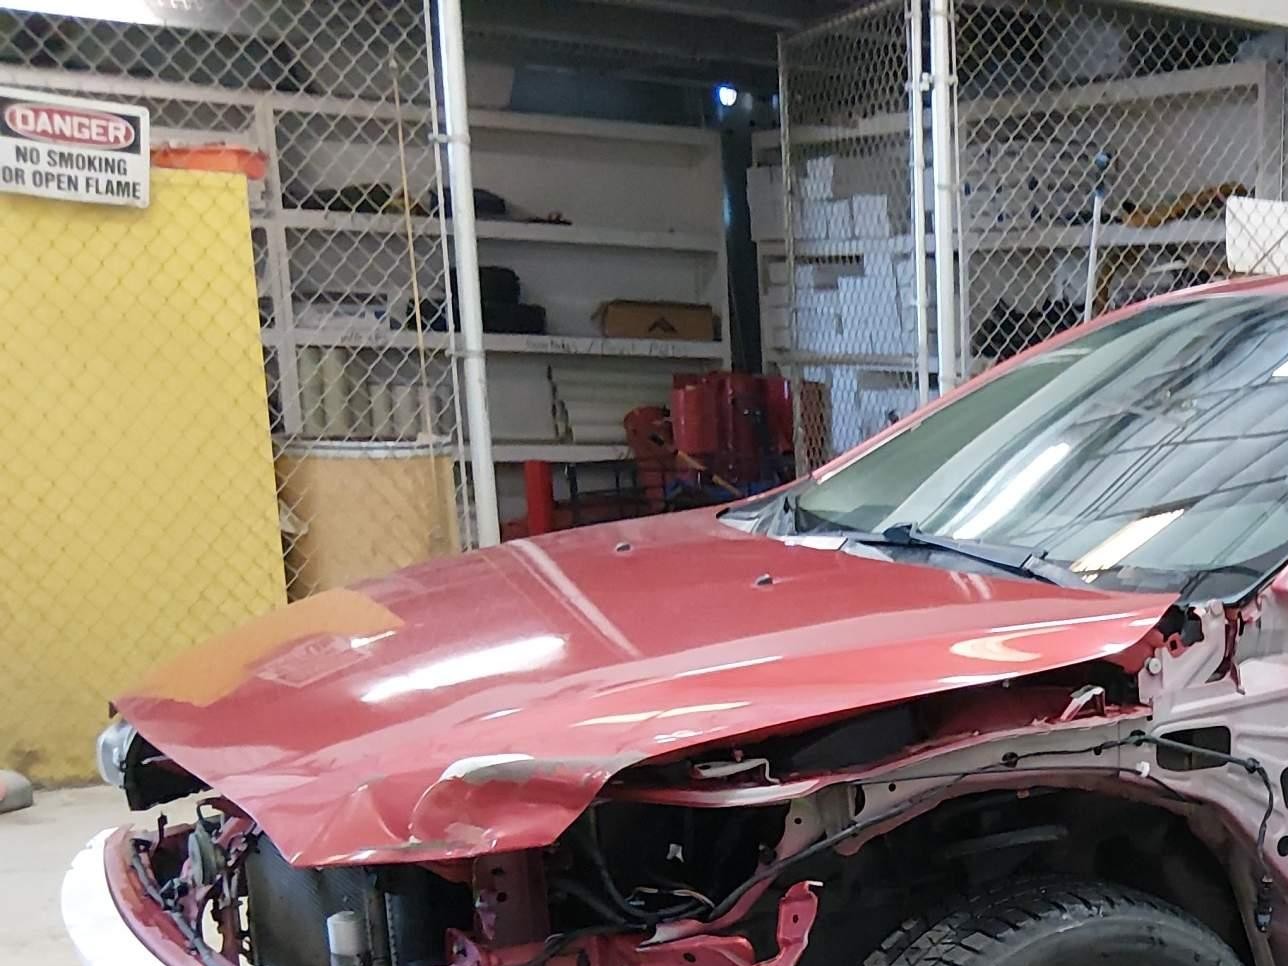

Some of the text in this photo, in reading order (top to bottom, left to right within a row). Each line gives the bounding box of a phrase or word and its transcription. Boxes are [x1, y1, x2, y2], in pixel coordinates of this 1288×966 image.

[15, 107, 127, 144] DANGER
[15, 145, 127, 176] NO SMOKING
[2, 166, 141, 200] OR OPEN FLAME
